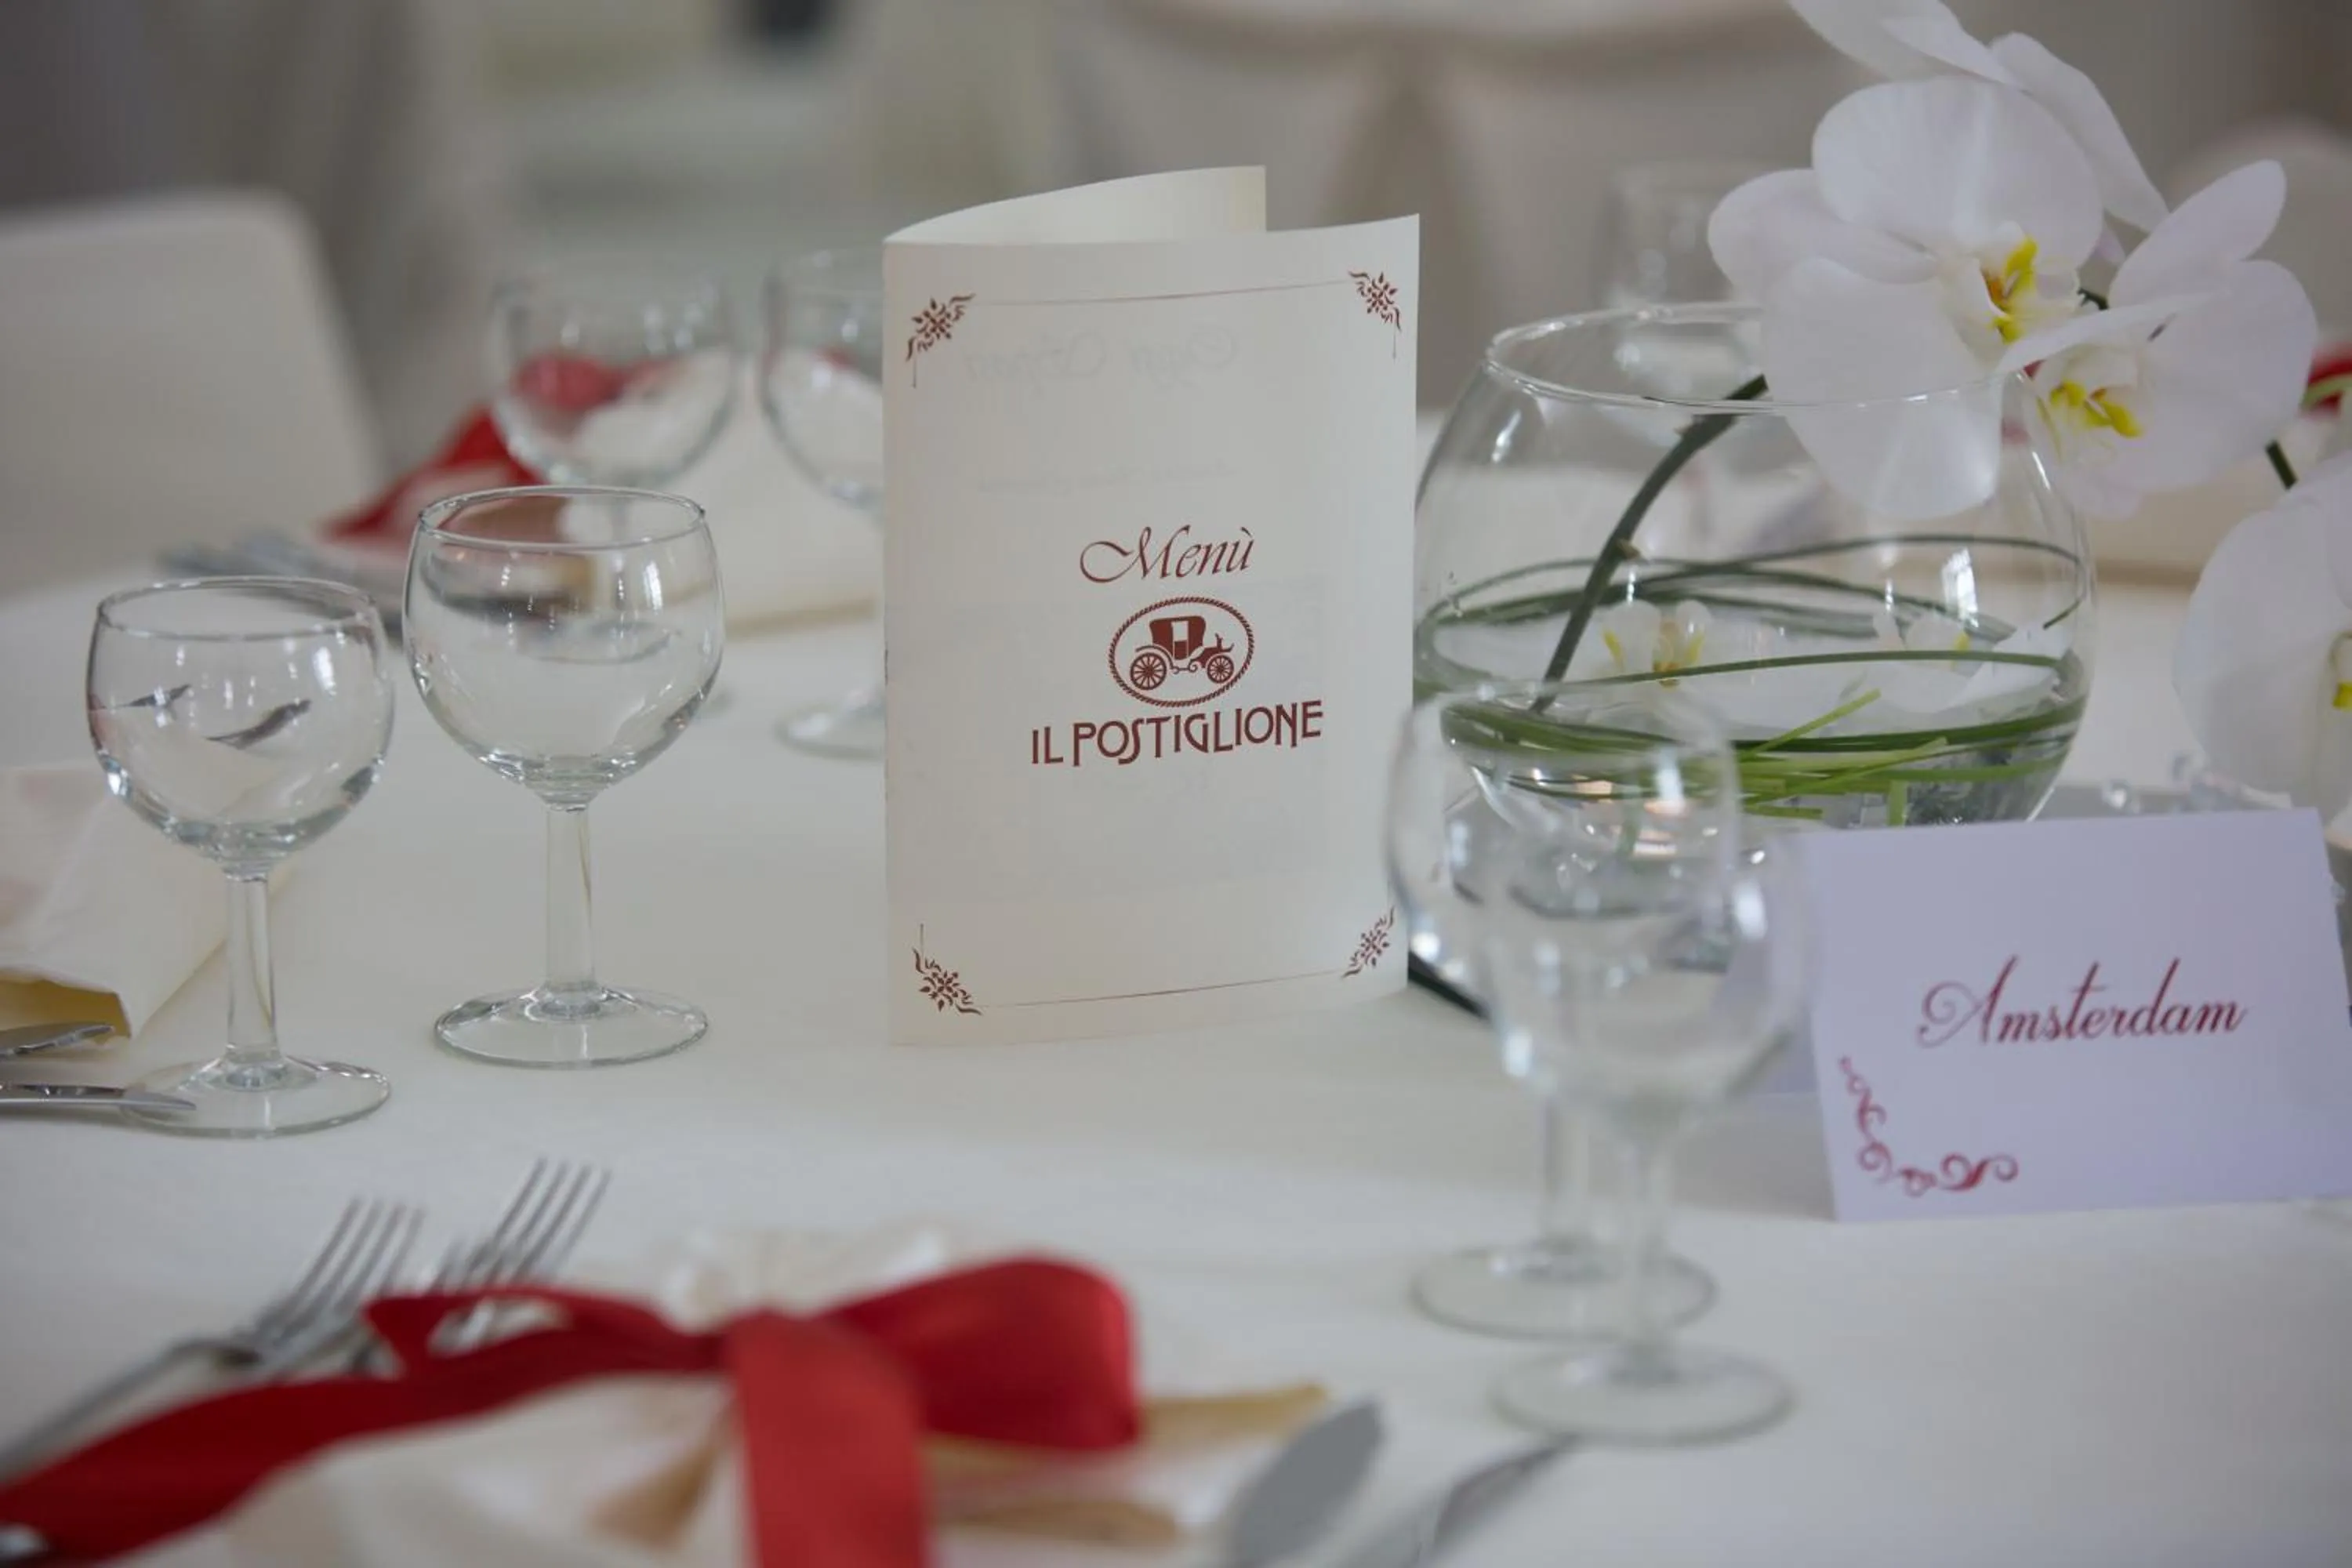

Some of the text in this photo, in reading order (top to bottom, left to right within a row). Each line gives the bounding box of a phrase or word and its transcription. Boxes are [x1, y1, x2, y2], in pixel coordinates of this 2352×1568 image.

[1080, 524, 1254, 584] Menù
[1031, 699, 1323, 767] IL POSTIGLIONE
[1915, 954, 2249, 1049] Amsterdam
